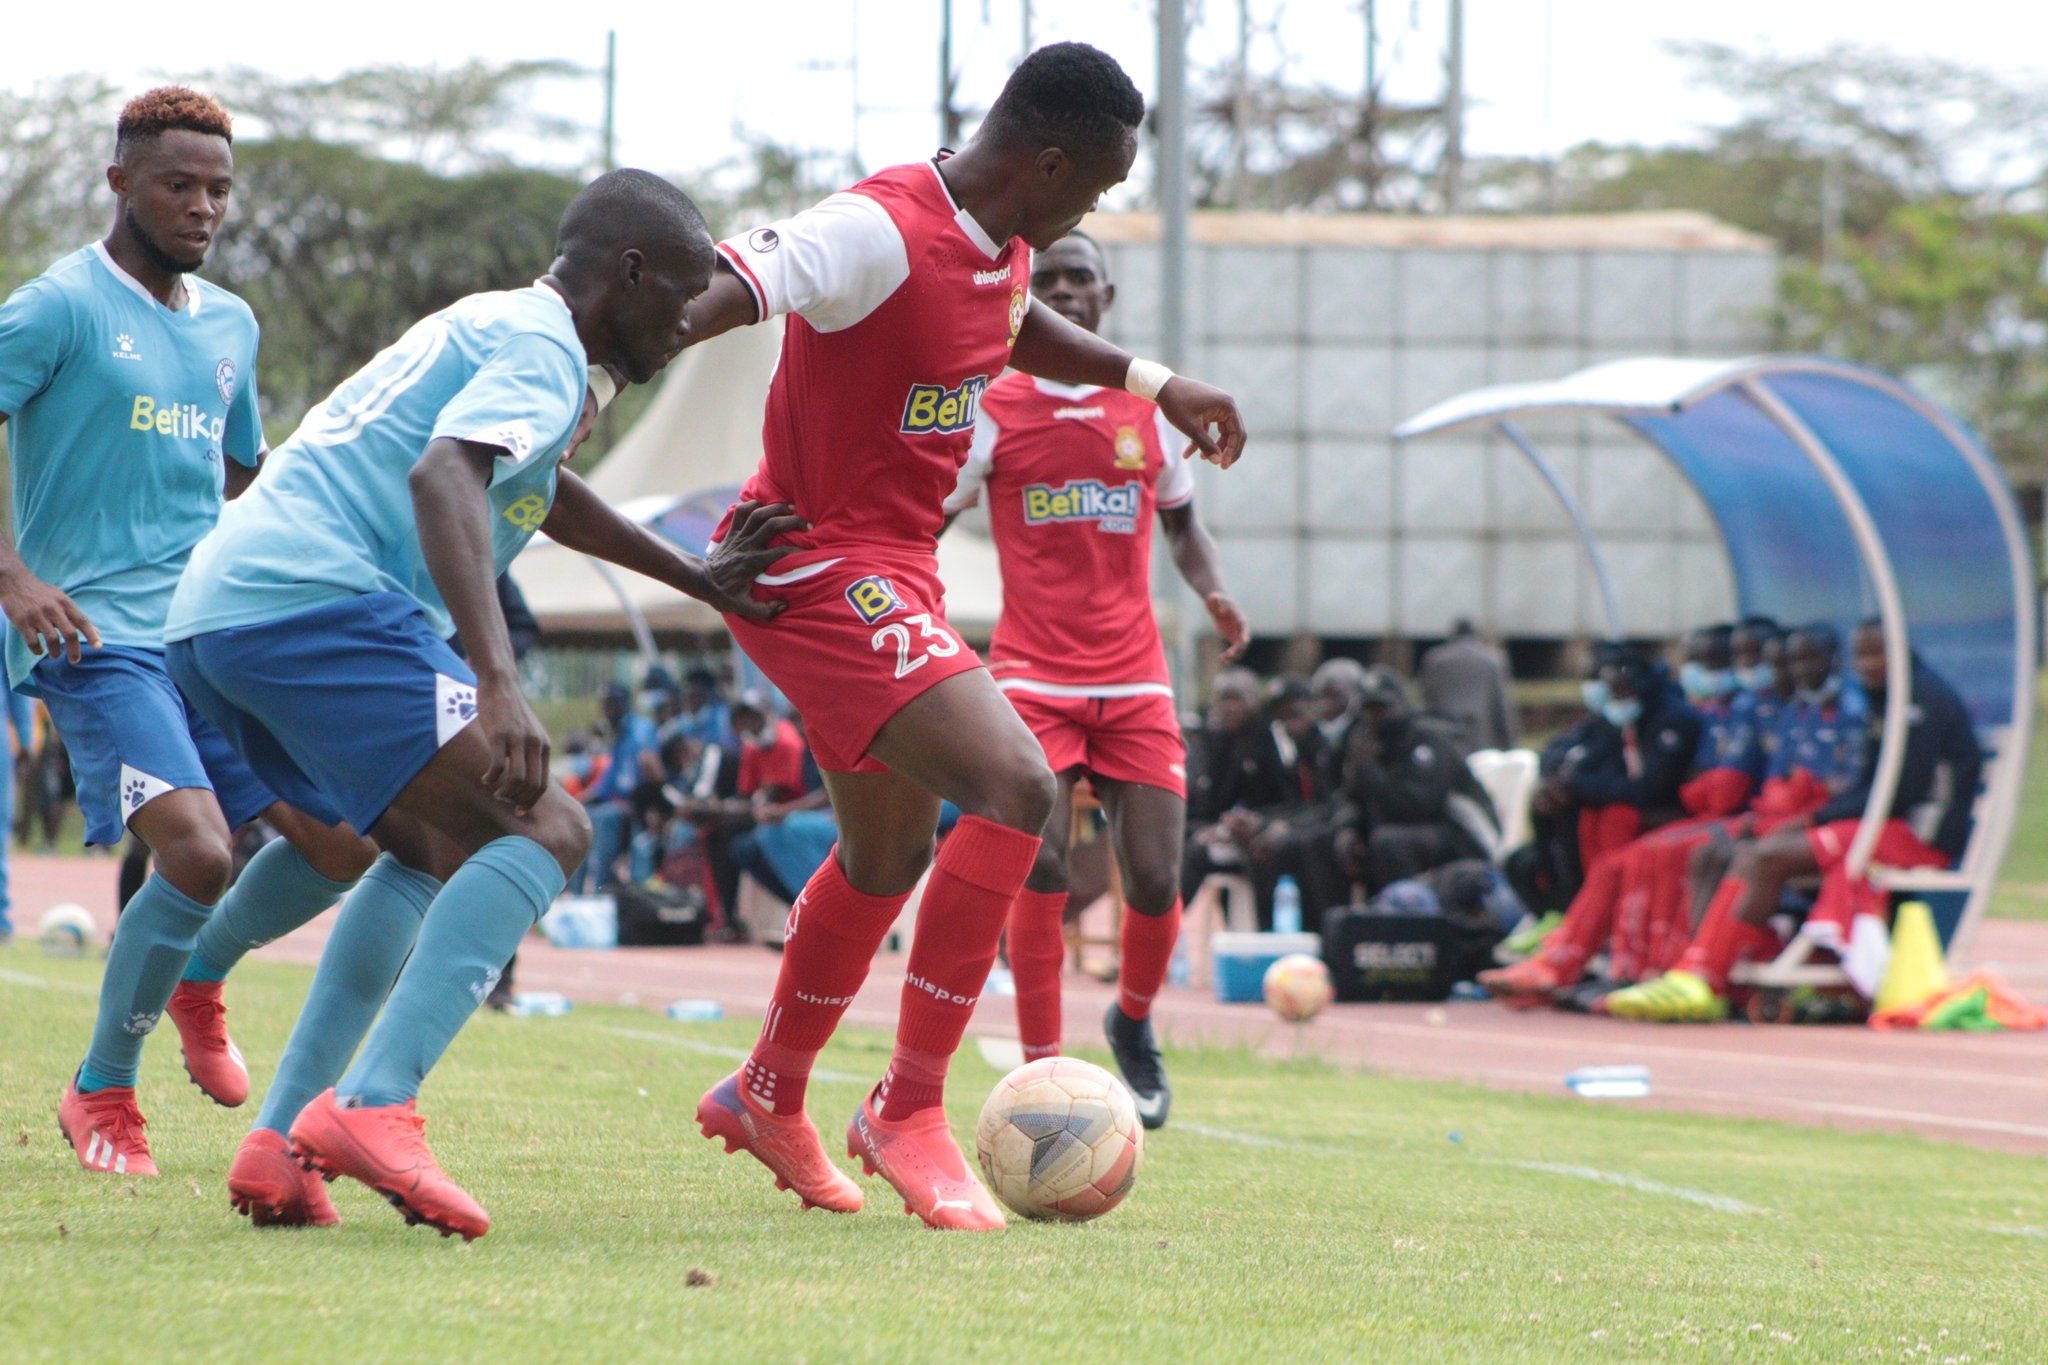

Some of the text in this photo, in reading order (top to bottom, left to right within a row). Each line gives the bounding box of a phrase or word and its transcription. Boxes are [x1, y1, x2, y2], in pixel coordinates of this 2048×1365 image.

[972, 264, 1011, 286] uhlsport
[112, 351, 143, 361] KELME
[1027, 484, 1139, 518] Betika!
[871, 613, 959, 680] 23
